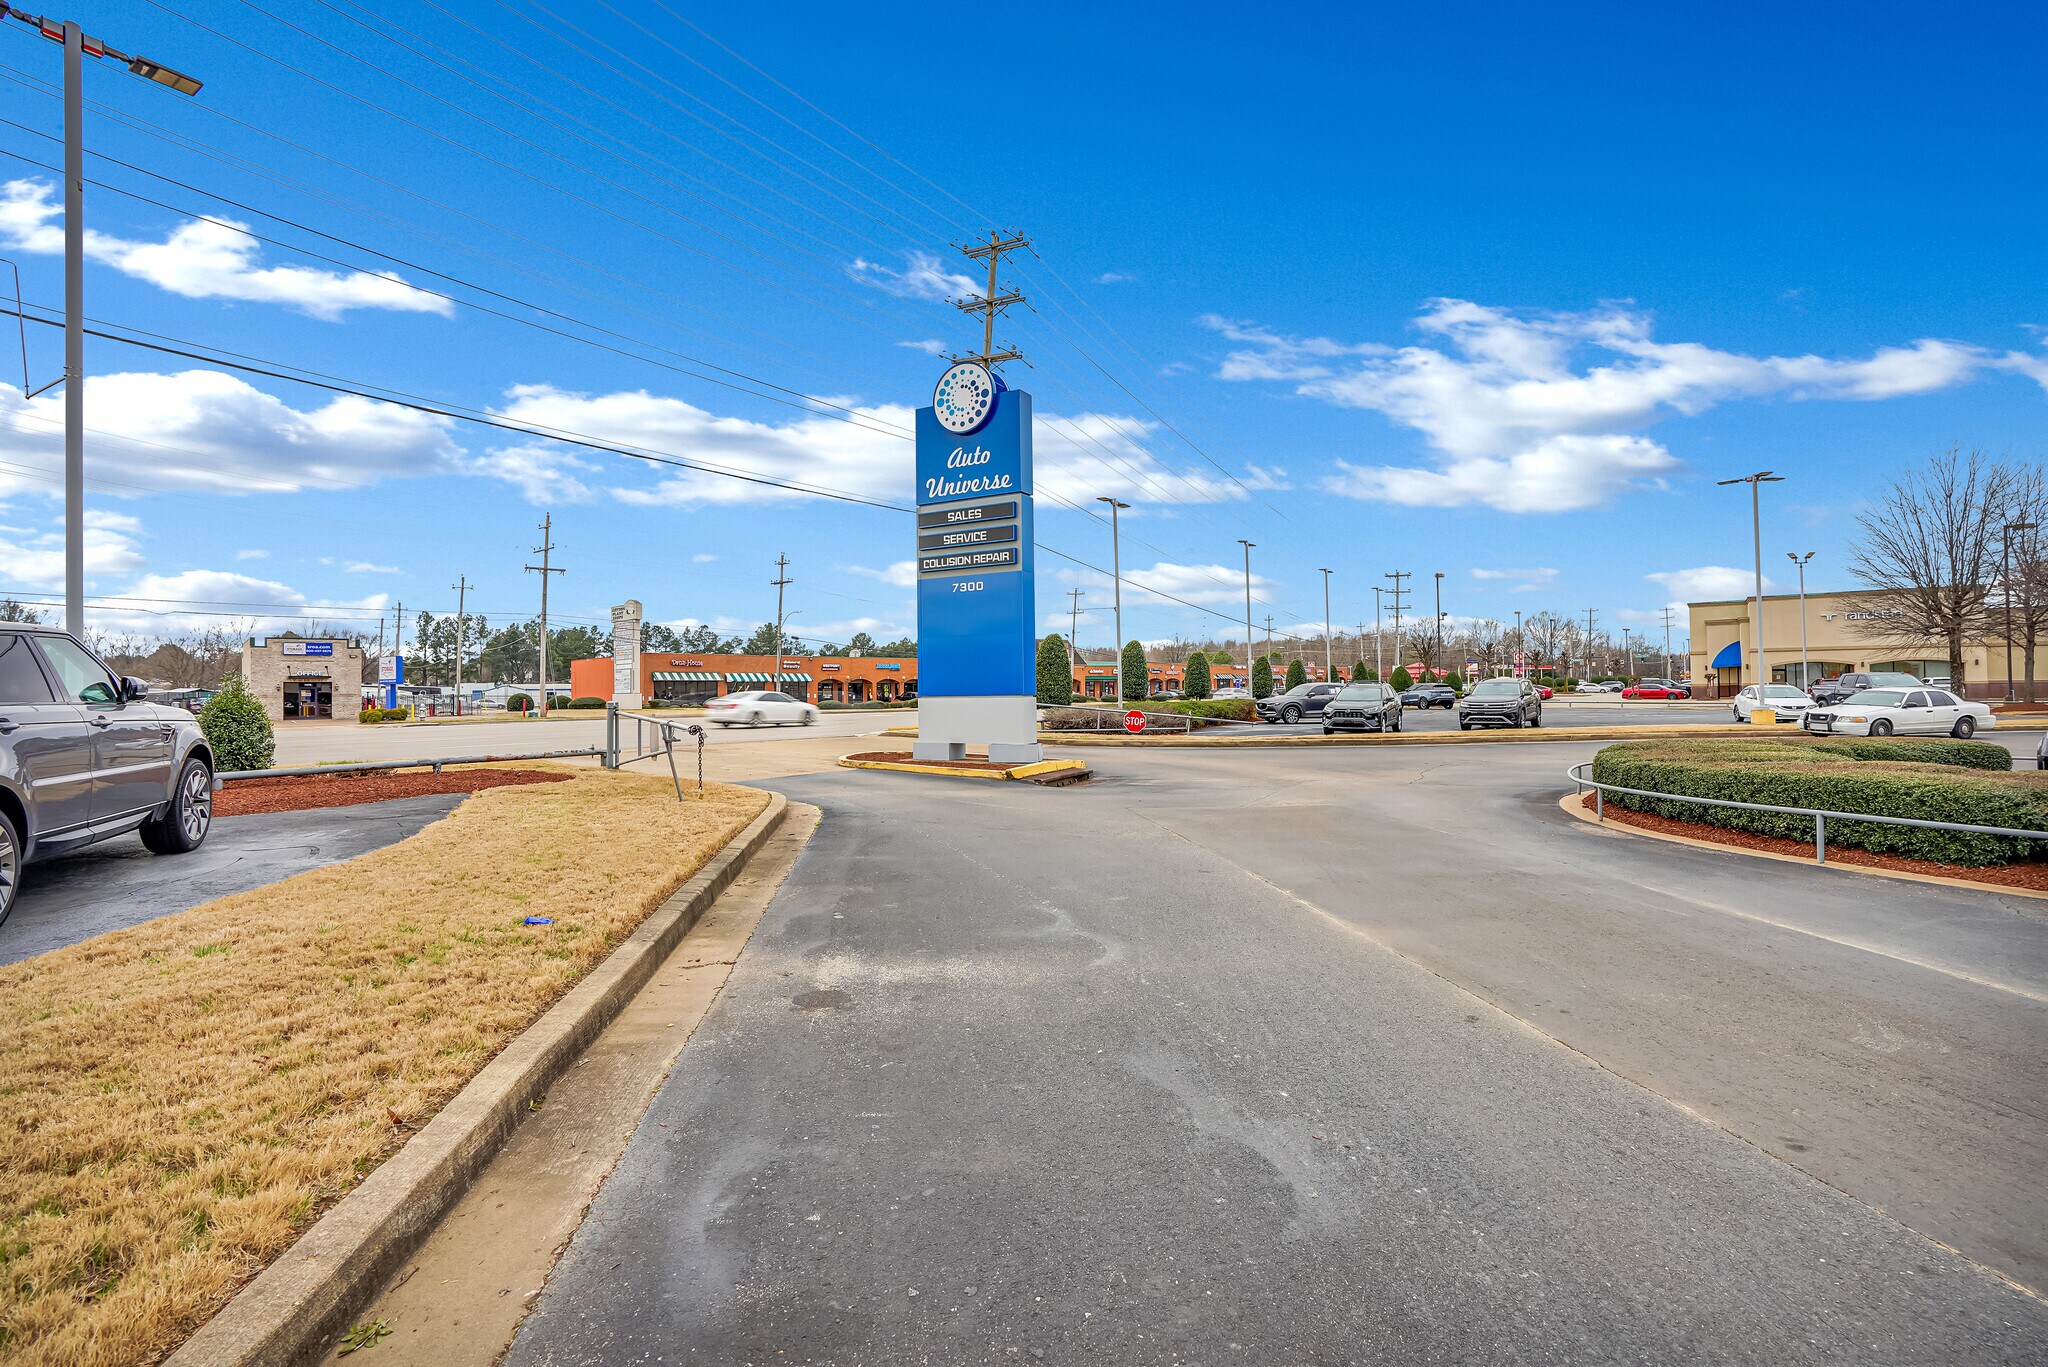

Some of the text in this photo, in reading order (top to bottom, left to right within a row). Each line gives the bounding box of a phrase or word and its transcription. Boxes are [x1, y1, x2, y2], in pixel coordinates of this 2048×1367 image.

[947, 446, 990, 469] Auto
[926, 474, 1013, 498] Universe
[947, 509, 982, 522] SALES
[943, 531, 987, 545] SERVICE
[923, 551, 1010, 569] COLLISION REPAIR
[952, 581, 984, 593] 7300
[1125, 716, 1145, 726] STOP
